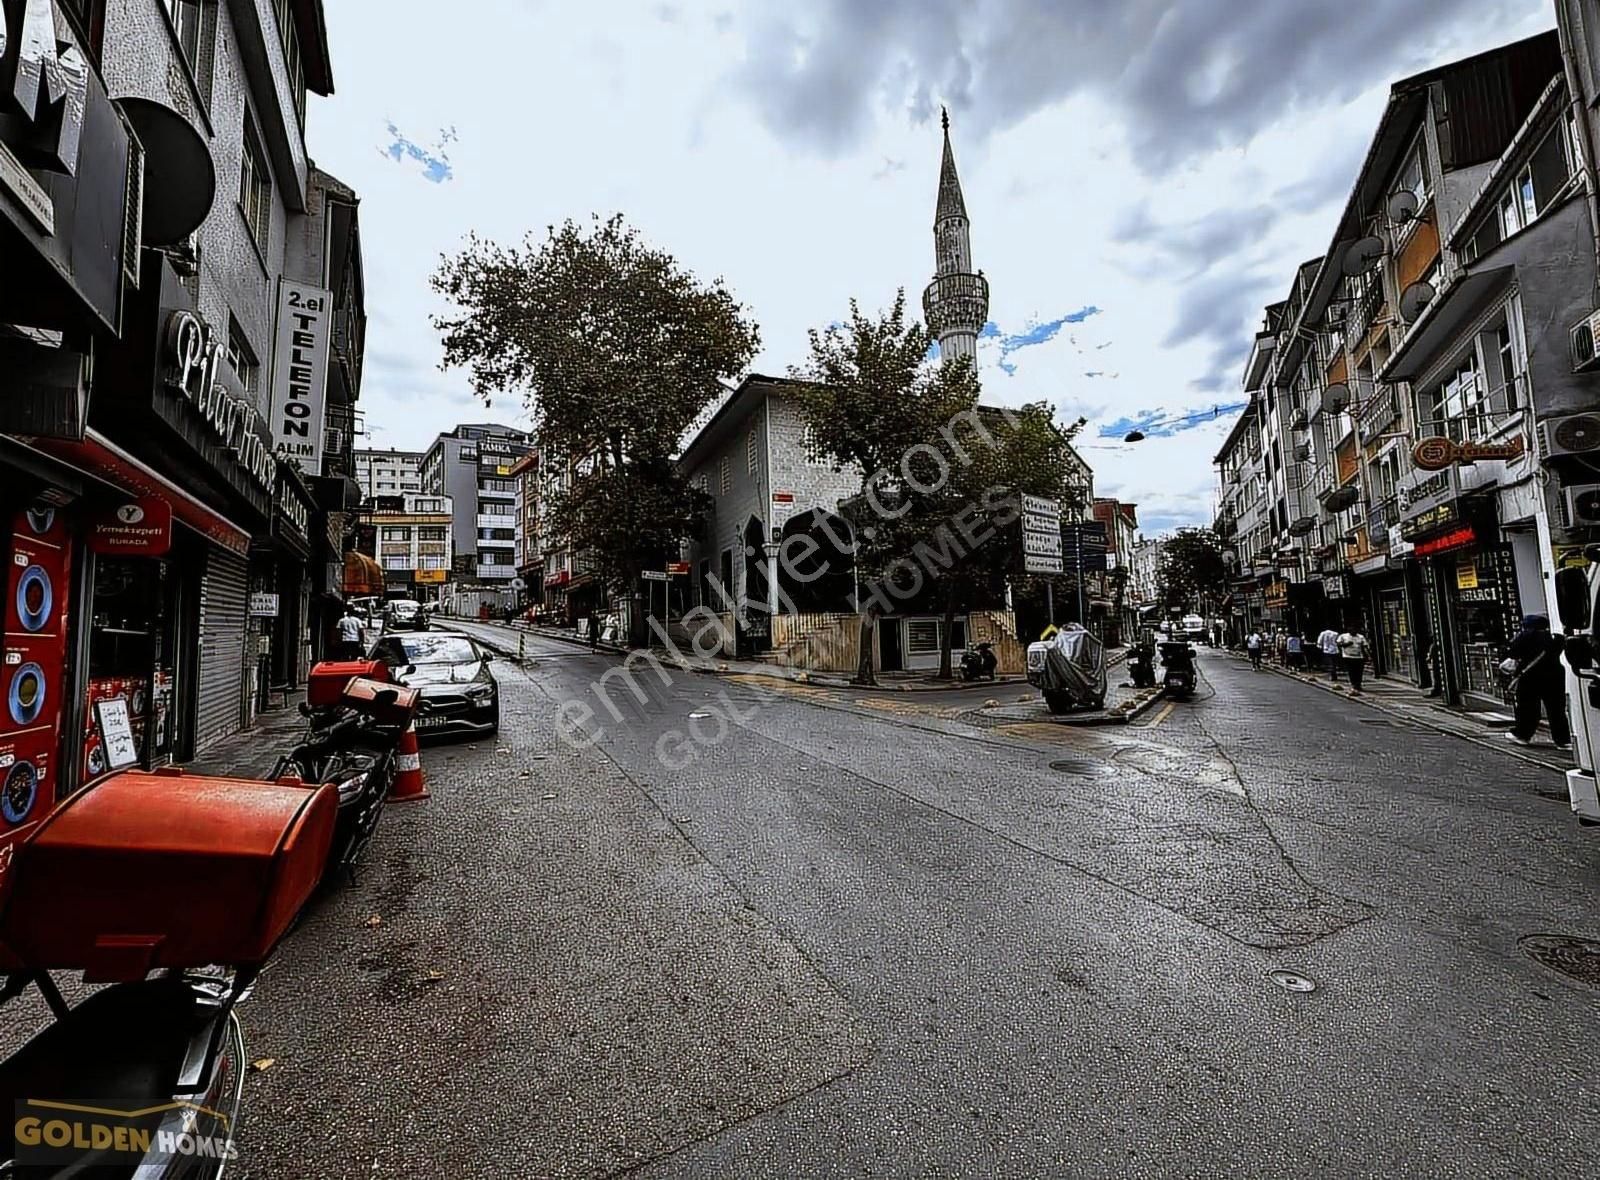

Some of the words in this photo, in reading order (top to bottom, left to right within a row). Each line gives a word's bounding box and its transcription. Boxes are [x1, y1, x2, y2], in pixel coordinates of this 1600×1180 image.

[288, 291, 324, 313] 2.el
[283, 313, 317, 438] TELEFON
[276, 442, 315, 457] ALIM
[96, 524, 162, 536] Yemeksepeti
